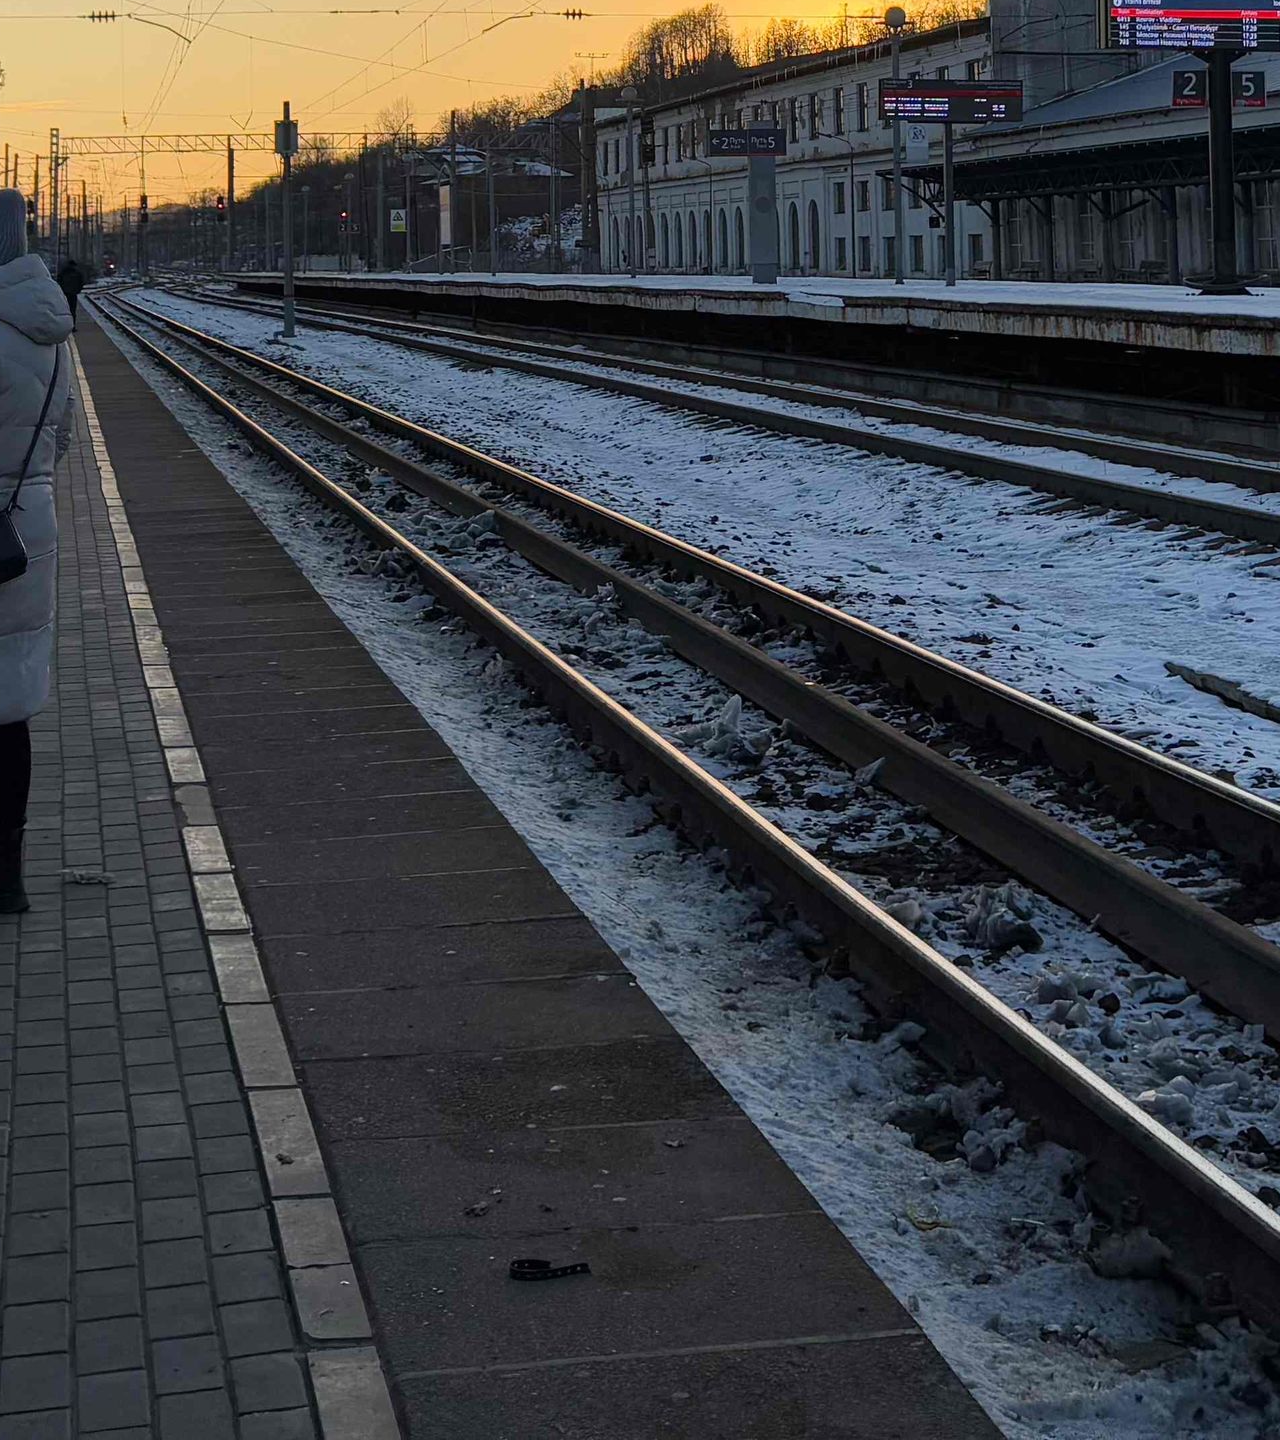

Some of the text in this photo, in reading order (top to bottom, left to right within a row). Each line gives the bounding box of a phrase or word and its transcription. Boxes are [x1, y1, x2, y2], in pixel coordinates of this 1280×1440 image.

[907, 80, 913, 88] 3
[1182, 72, 1197, 96] 2
[1241, 73, 1255, 97] 5
[721, 137, 746, 149] 2 Путь
[751, 136, 775, 149] Путь 5
